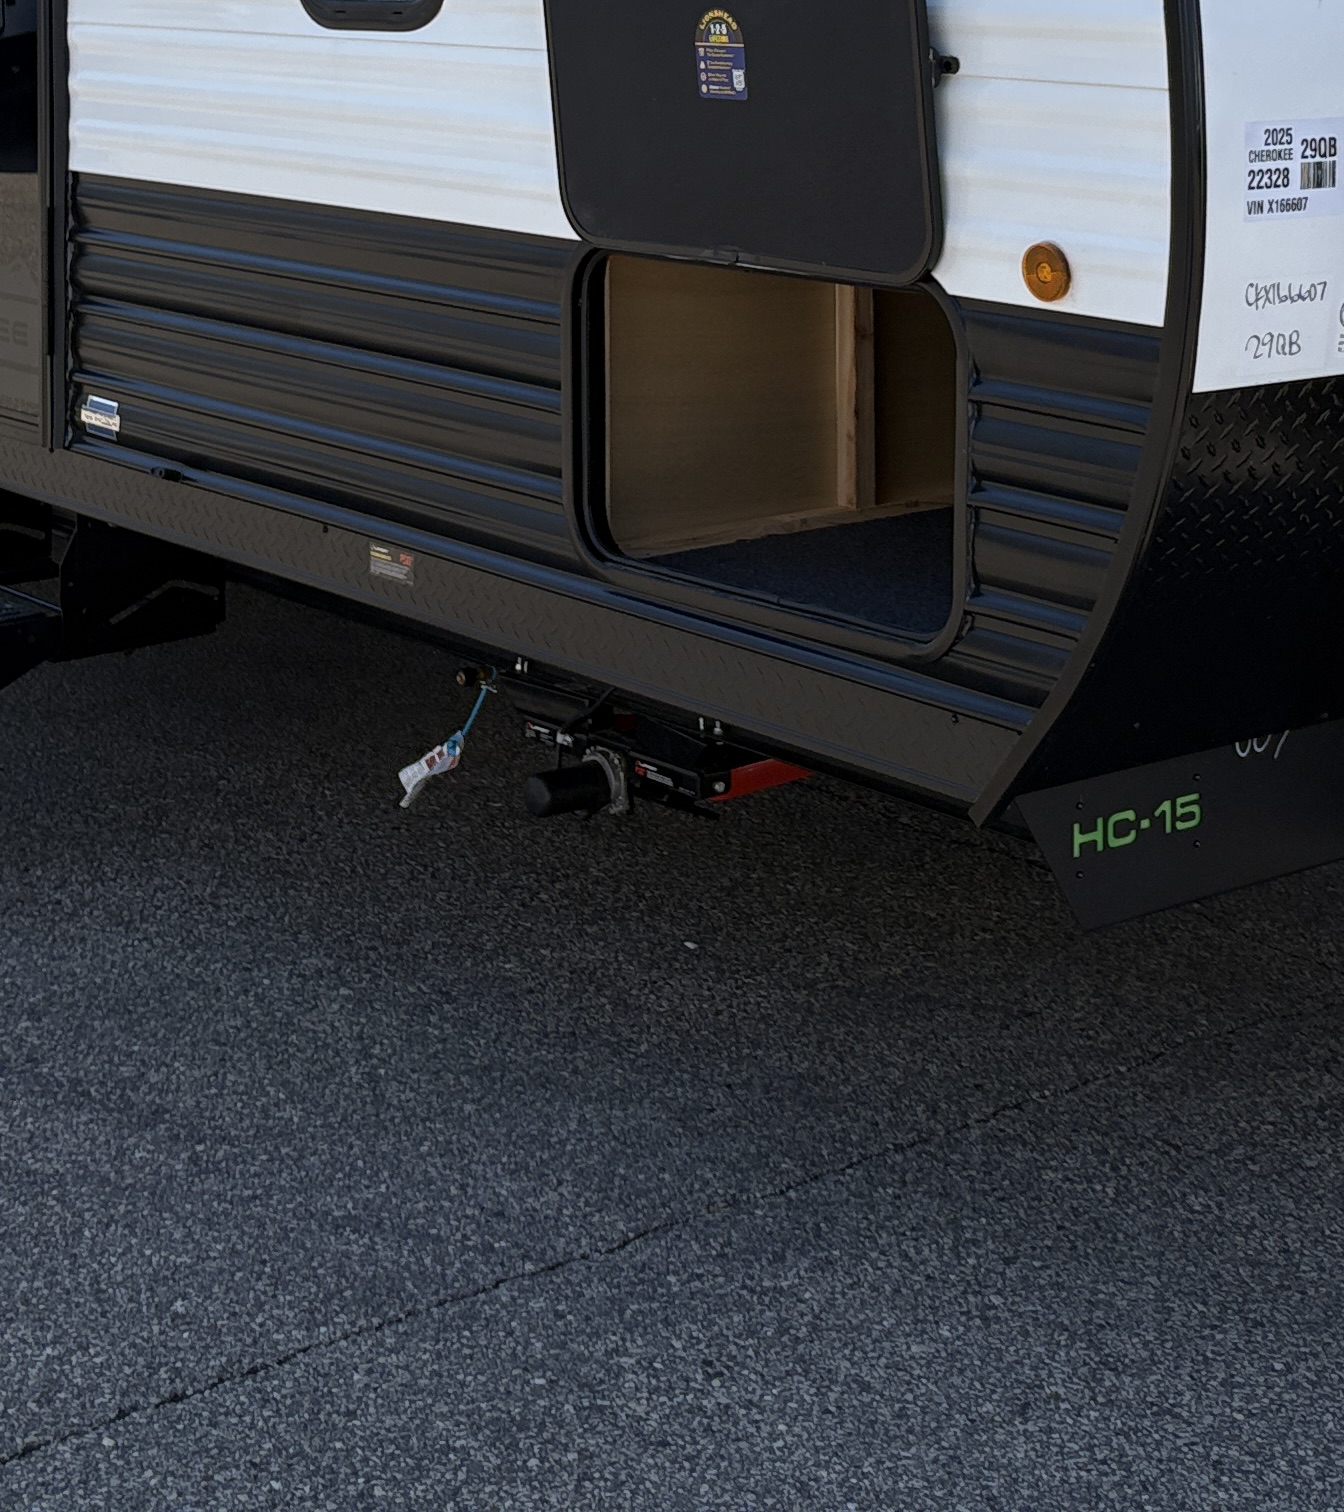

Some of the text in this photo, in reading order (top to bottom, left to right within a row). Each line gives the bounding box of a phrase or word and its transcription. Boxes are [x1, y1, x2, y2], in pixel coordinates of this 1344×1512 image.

[1263, 127, 1293, 147] 2025
[1300, 136, 1338, 159] 29QB
[1248, 147, 1294, 164] CHEROKEE
[1247, 167, 1290, 191] 22328
[1246, 196, 1309, 215] VIN X166607
[1244, 329, 1302, 360] 29QB
[1072, 792, 1202, 858] HC-15
